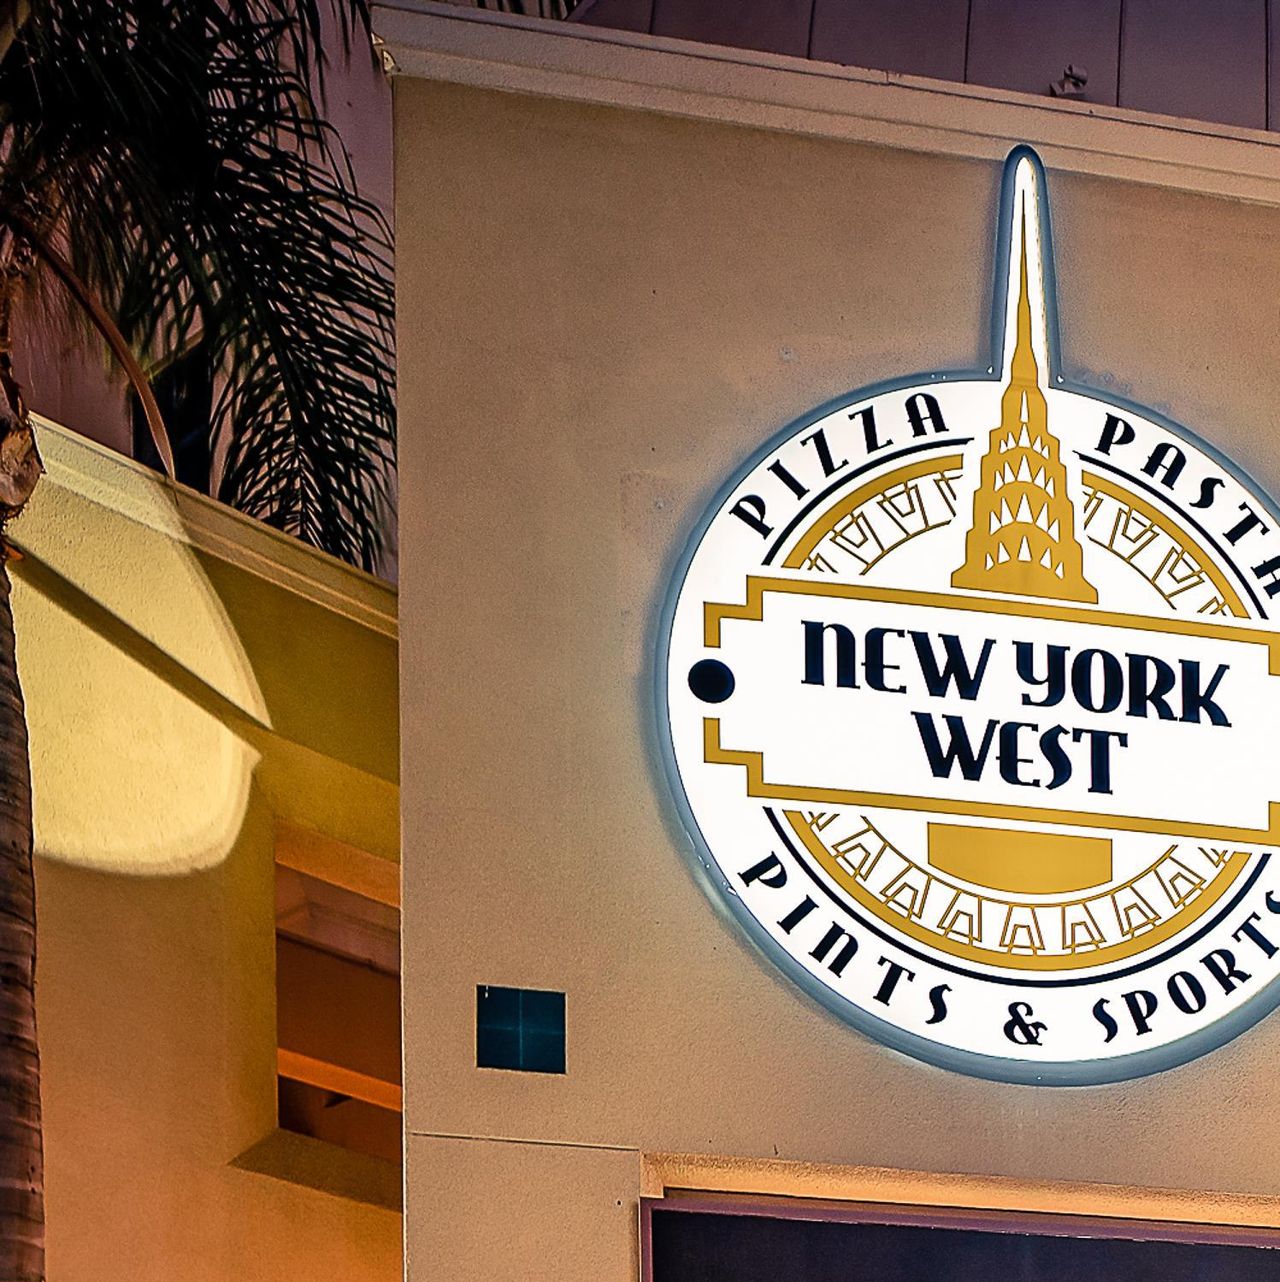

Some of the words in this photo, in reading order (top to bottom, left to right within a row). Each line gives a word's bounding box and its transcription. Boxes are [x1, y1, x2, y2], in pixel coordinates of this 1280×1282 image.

[729, 392, 951, 540] PIZZA
[800, 618, 997, 702] NEW
[1012, 640, 1233, 728] YORK
[910, 710, 1129, 796] WEST
[737, 851, 953, 1025] PINTS
[1003, 1000, 1049, 1047] &
